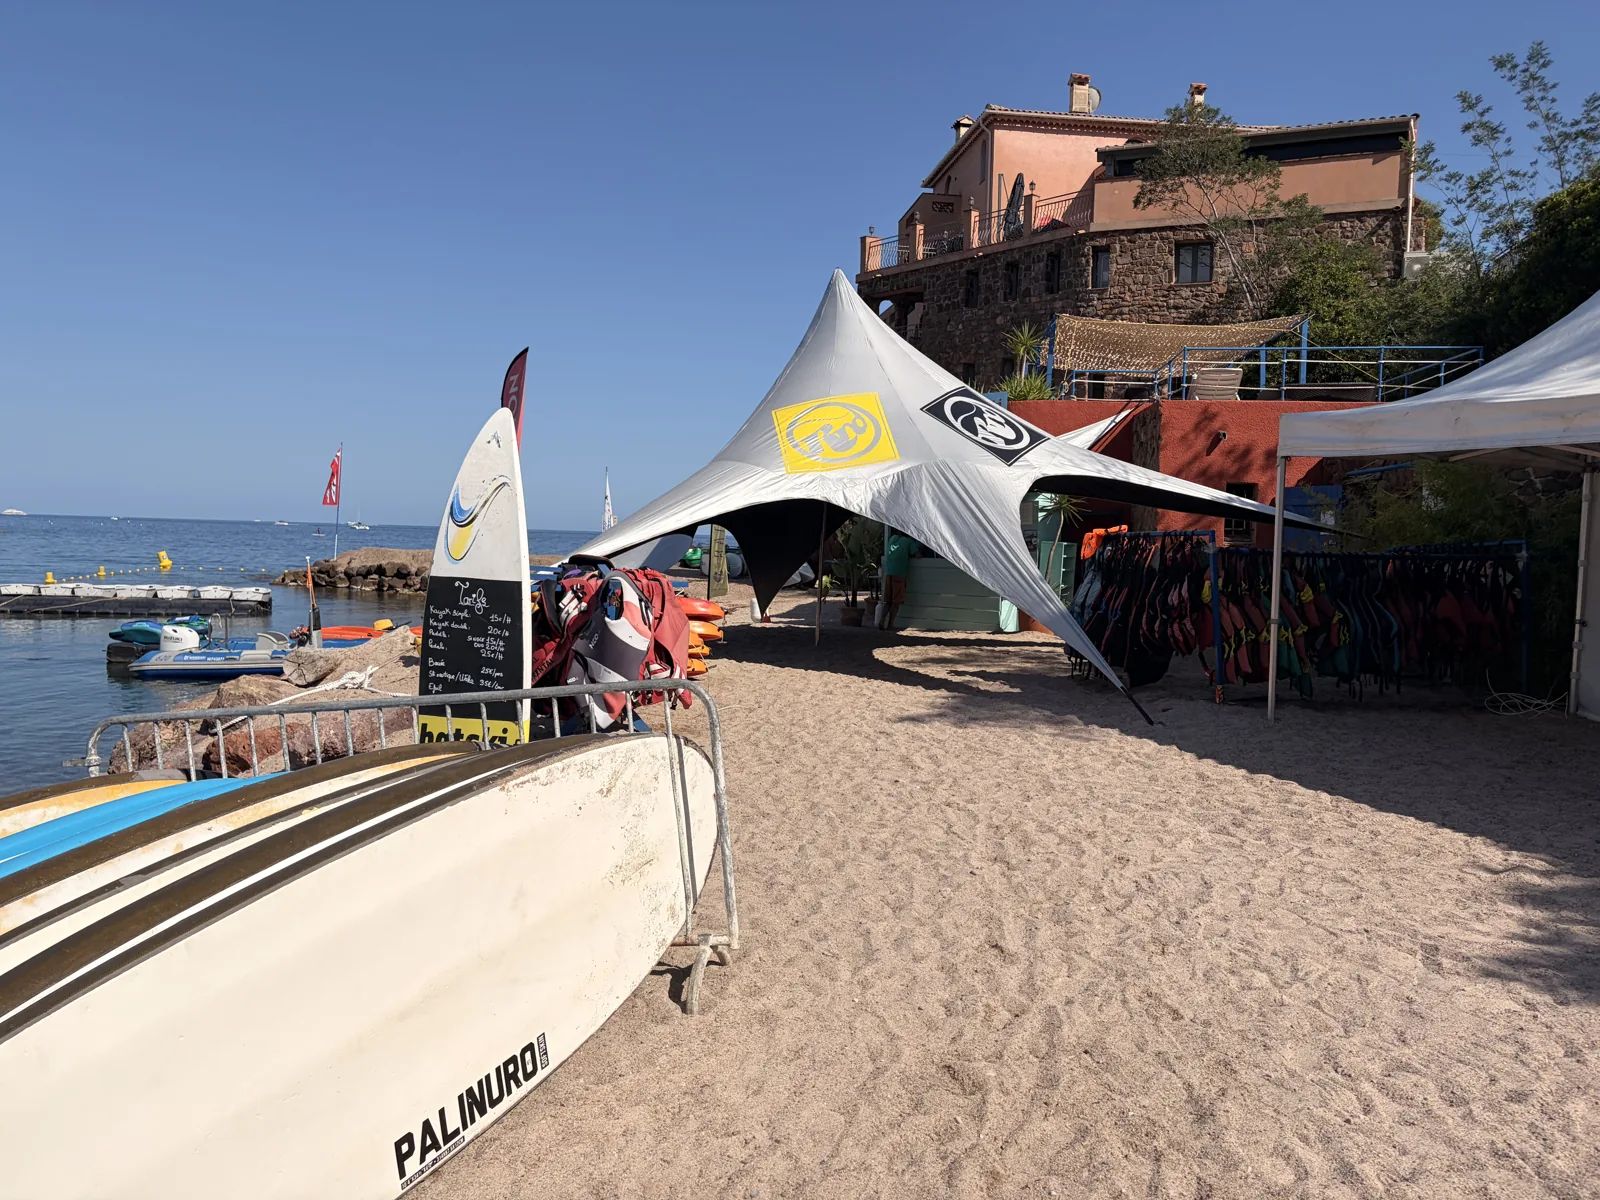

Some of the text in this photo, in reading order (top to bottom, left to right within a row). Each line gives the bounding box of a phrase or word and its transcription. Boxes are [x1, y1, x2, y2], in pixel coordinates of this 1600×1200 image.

[429, 605, 451, 619] Kayak
[455, 581, 490, 614] Tarifs
[394, 1041, 538, 1181] PALINURO
